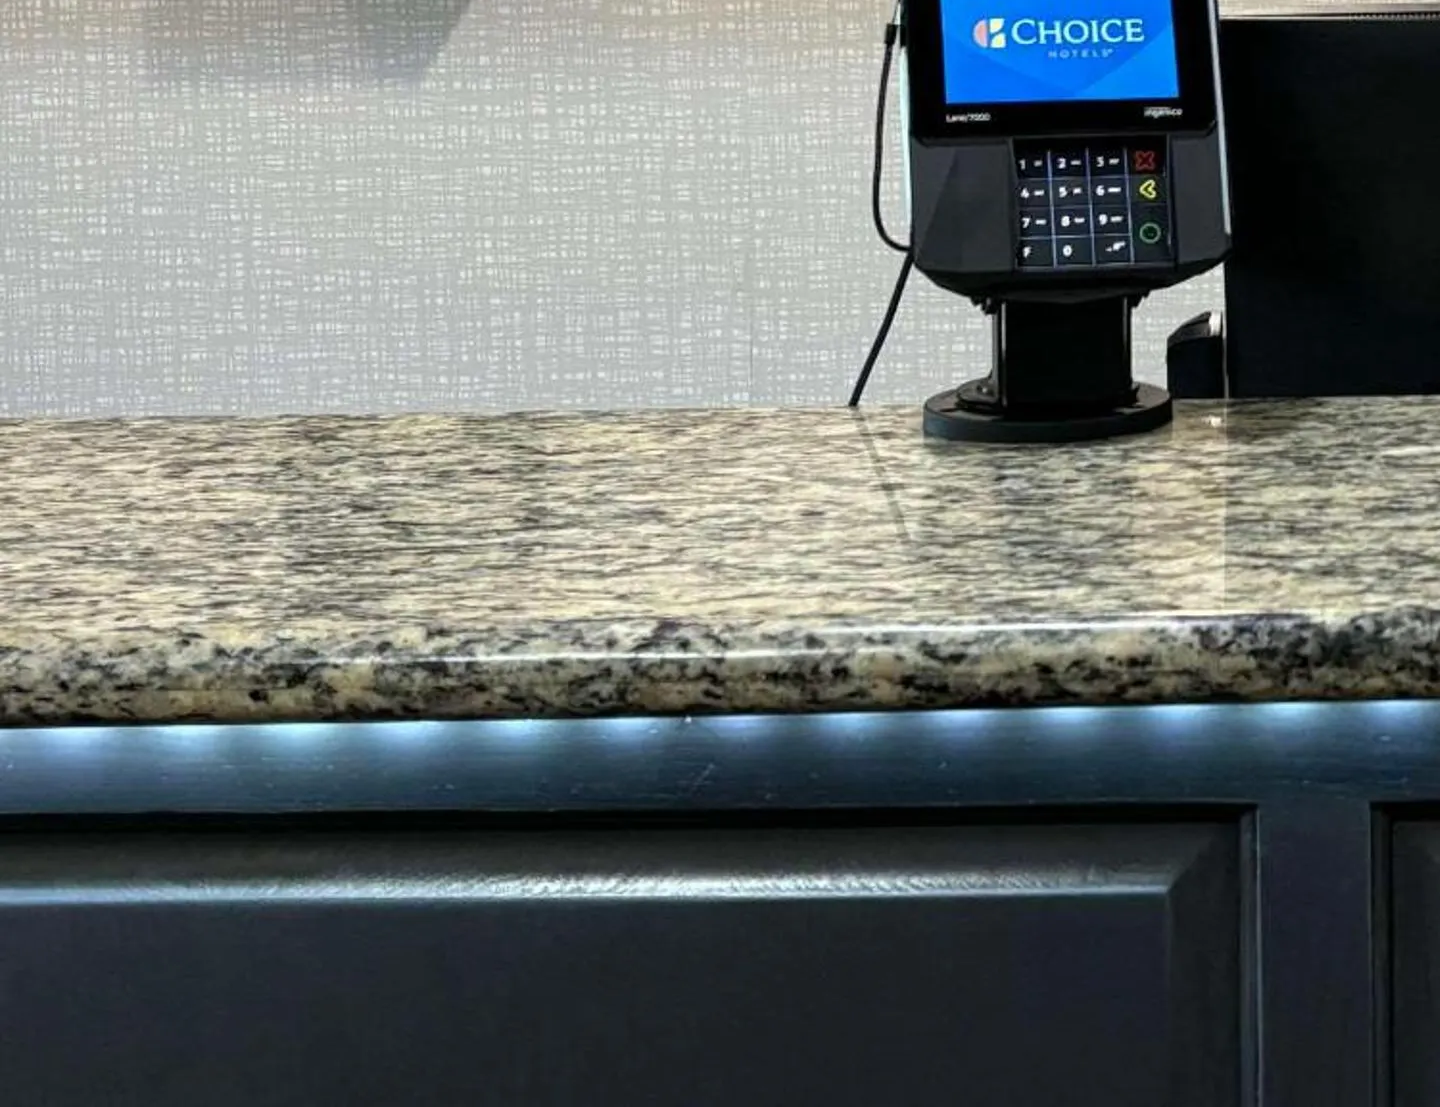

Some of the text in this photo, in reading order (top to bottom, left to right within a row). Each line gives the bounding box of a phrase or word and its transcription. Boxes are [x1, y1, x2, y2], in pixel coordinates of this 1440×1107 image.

[1011, 18, 1146, 45] CHOICE
[1019, 158, 1027, 170] 1
[1057, 157, 1067, 169] 2
[1020, 187, 1030, 199] 4
[1058, 186, 1068, 198] 5
[1095, 184, 1105, 197] 6
[1021, 217, 1031, 229] 7
[1060, 215, 1071, 228] 8
[1098, 213, 1108, 226] 9
